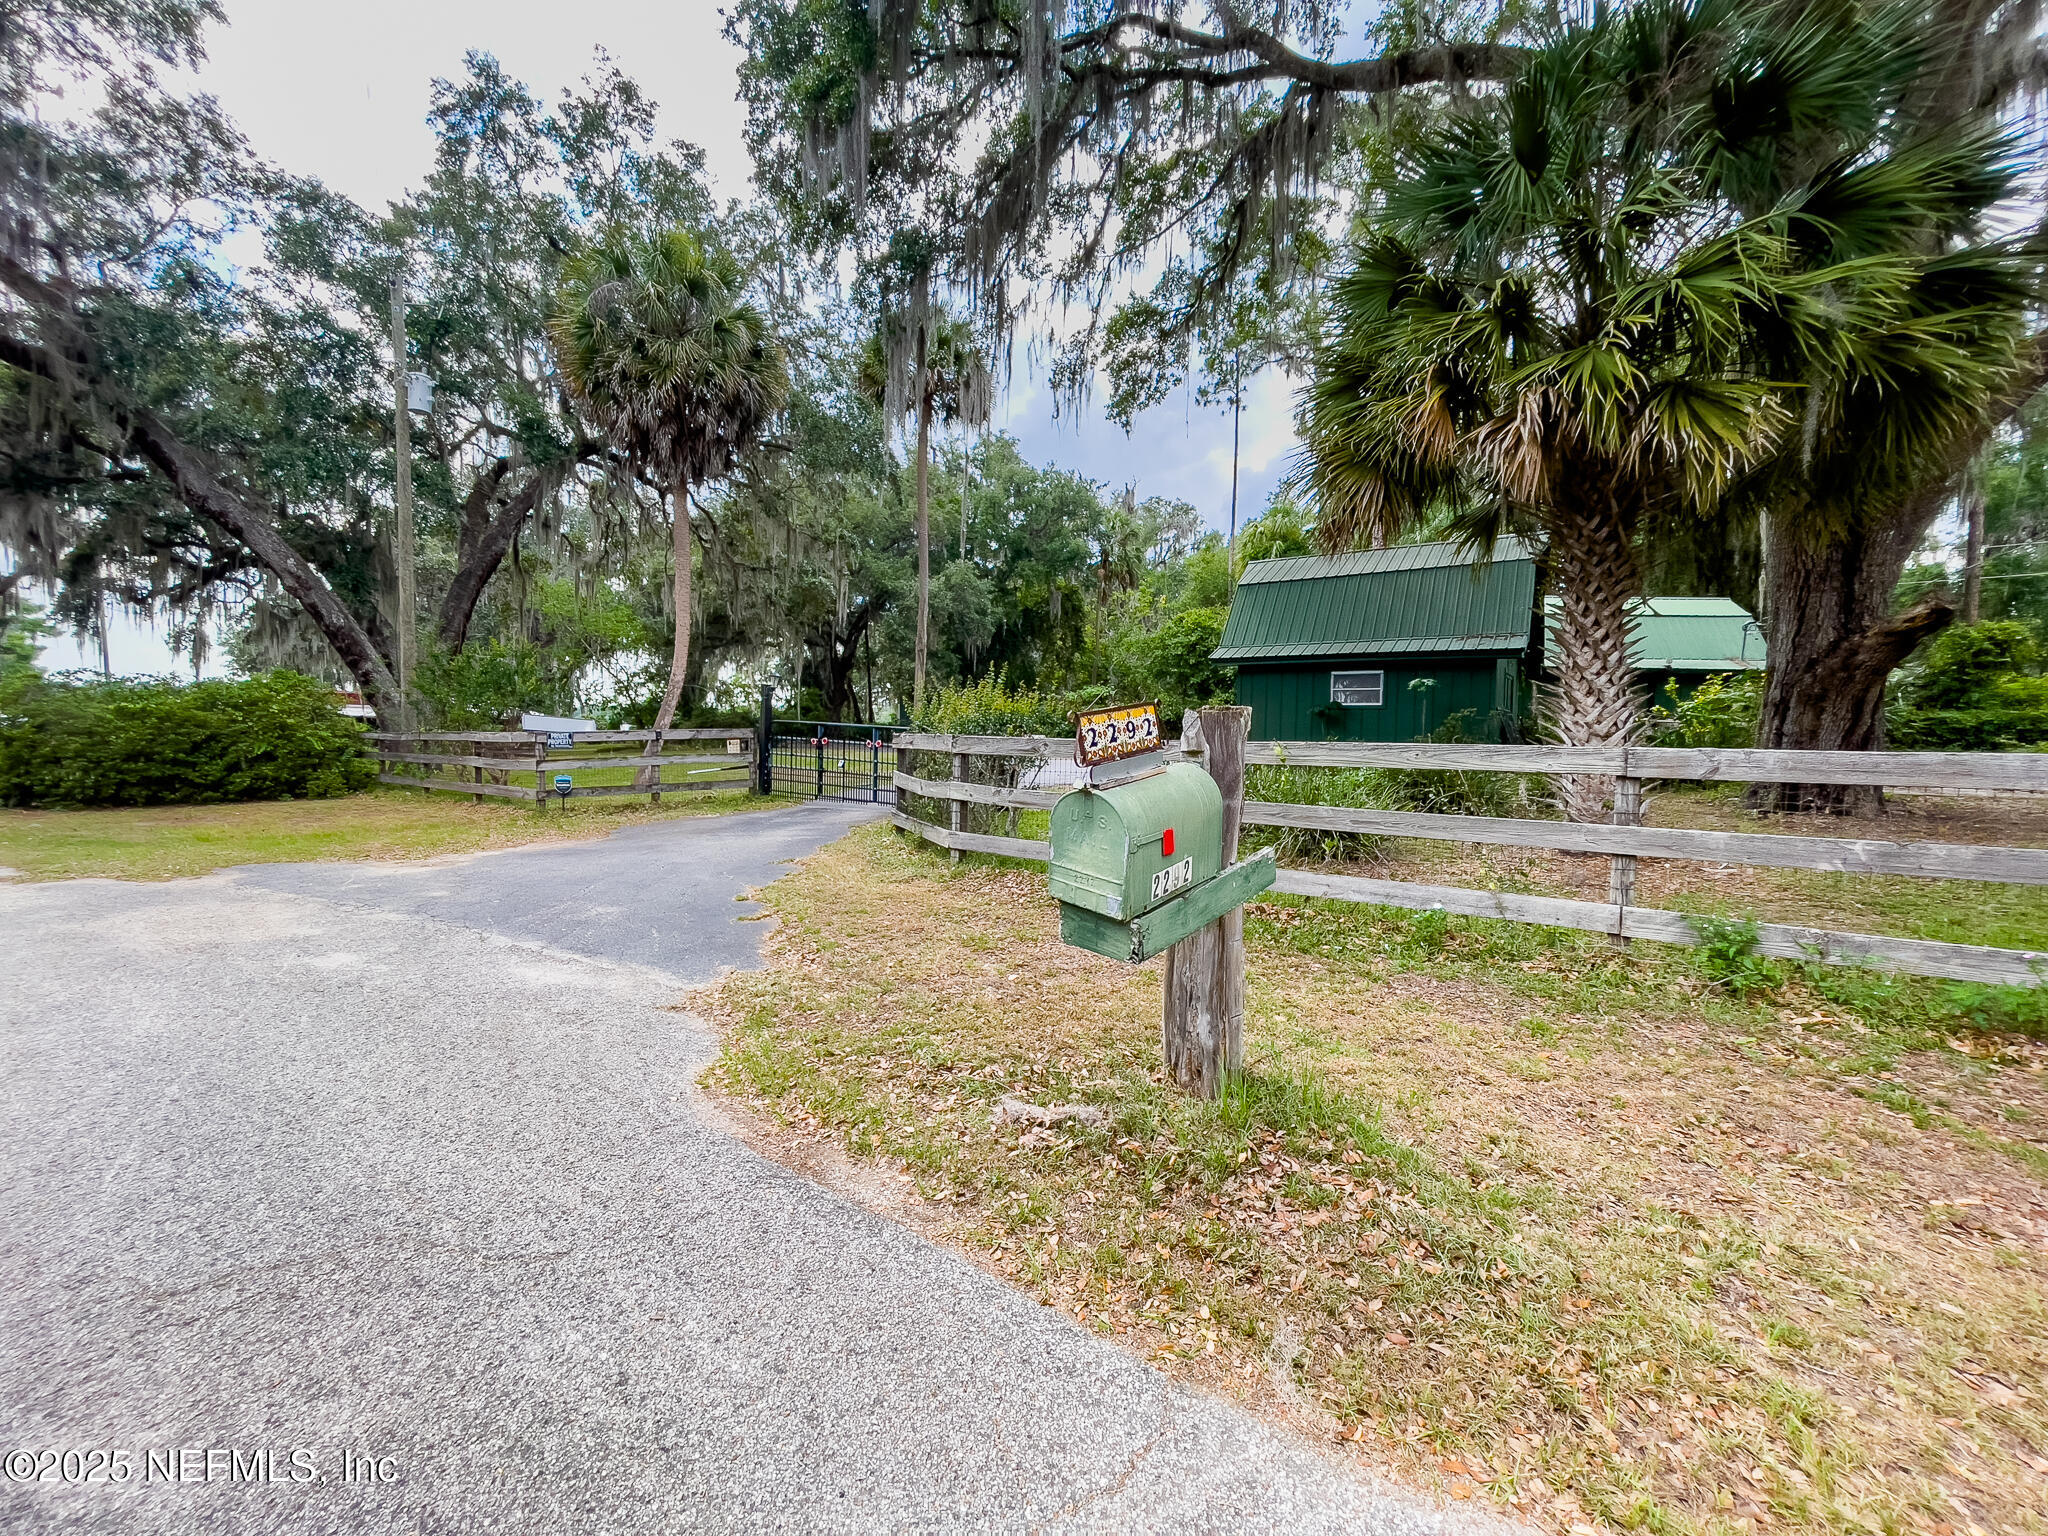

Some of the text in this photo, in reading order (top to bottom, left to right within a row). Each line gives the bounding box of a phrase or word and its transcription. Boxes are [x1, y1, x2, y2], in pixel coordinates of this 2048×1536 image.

[550, 732, 570, 740] PRIVATE
[1086, 717, 1153, 748] 2292
[1153, 860, 1190, 900] 2292
